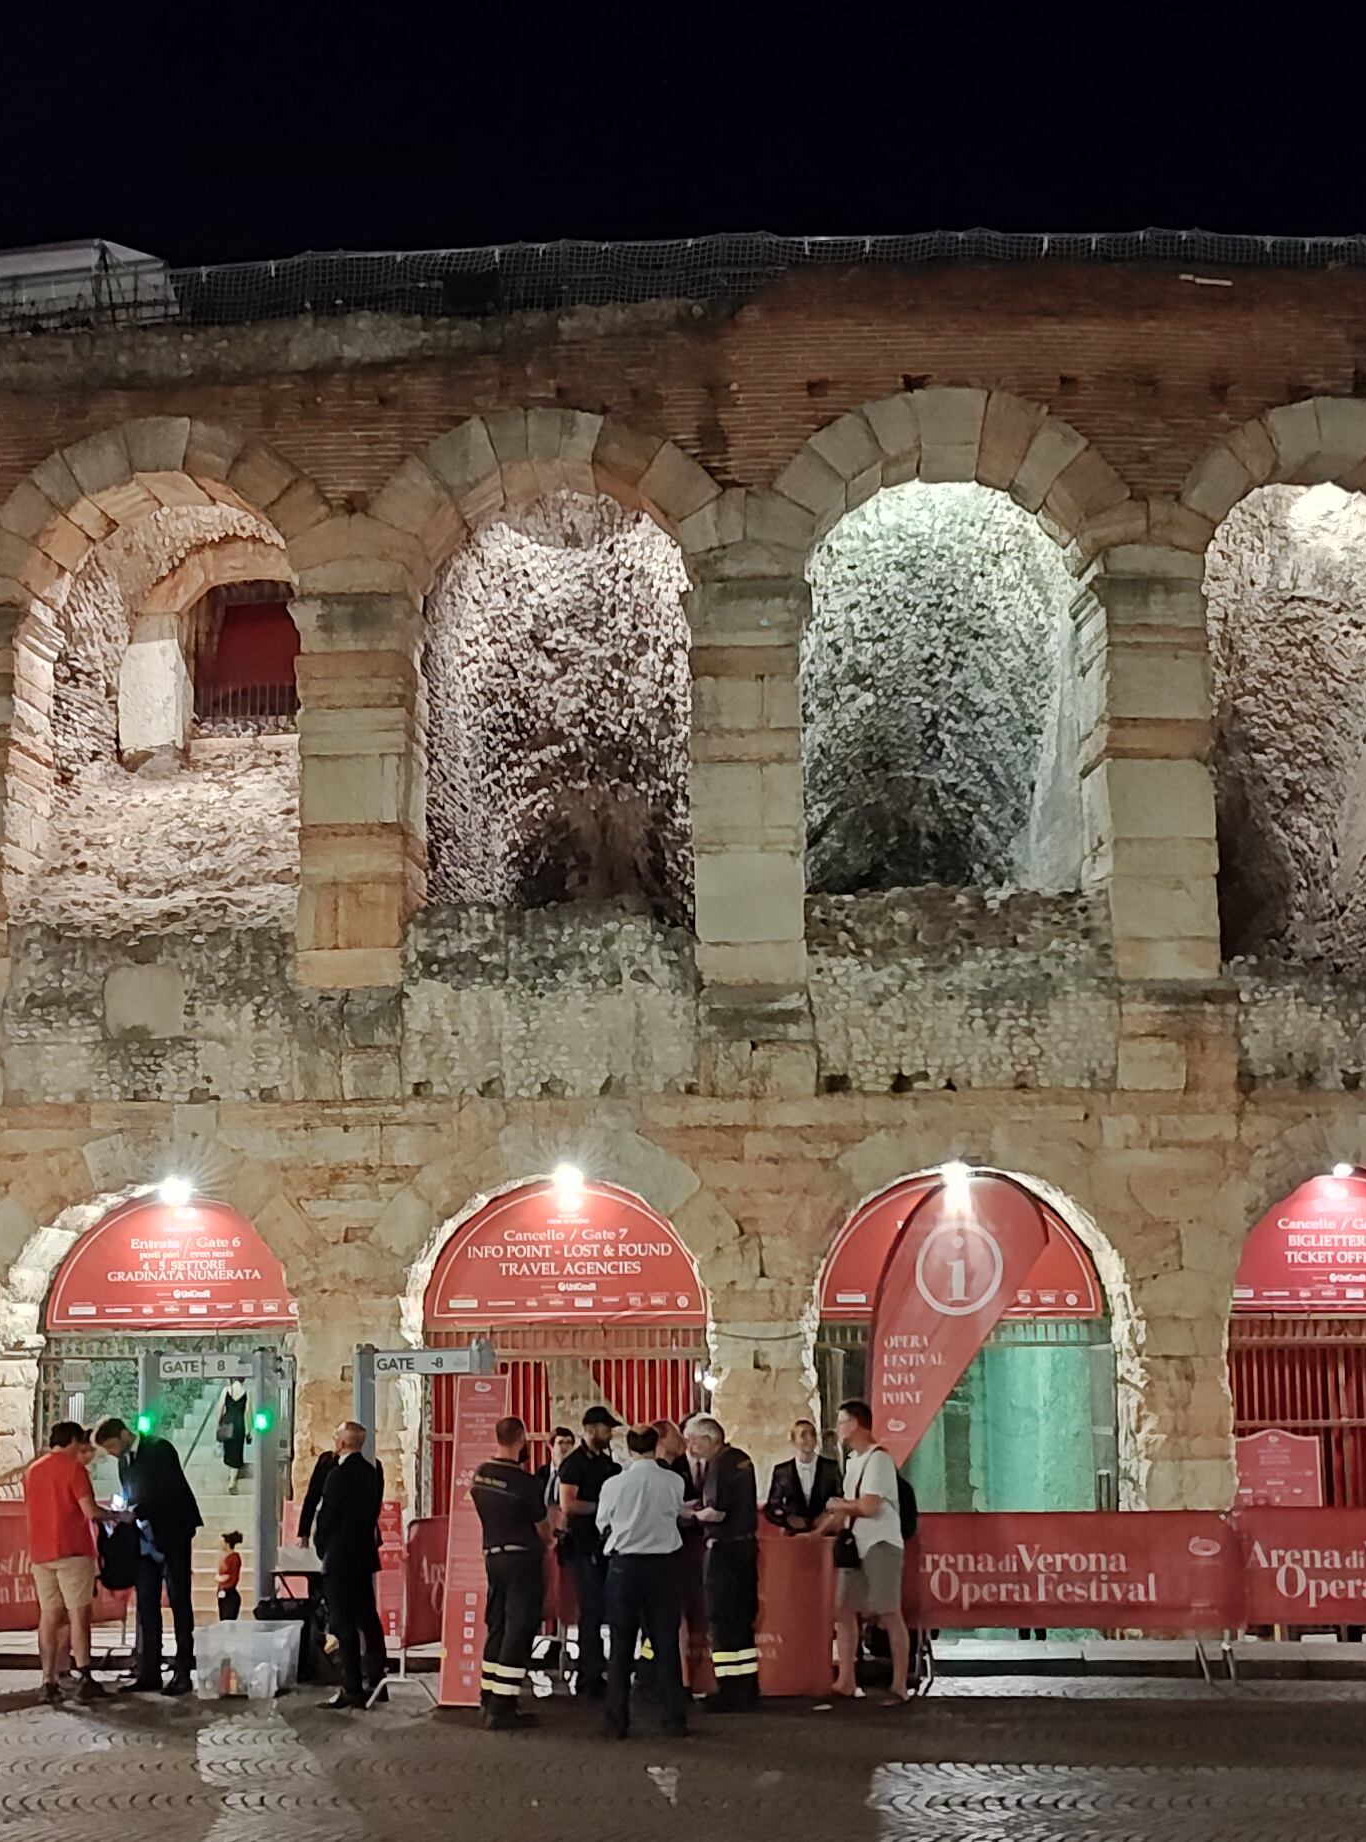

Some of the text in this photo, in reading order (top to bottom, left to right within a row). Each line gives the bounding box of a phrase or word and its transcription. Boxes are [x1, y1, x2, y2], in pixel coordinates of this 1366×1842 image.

[1277, 1218, 1337, 1230] Cancello
[503, 1229, 565, 1241] Cancello
[581, 1229, 615, 1241] Gate
[618, 1228, 629, 1241] 7
[196, 1236, 230, 1249] Gate
[231, 1236, 242, 1248] 6
[467, 1245, 503, 1259] INFO
[506, 1245, 552, 1258] POINT
[563, 1244, 600, 1257] LOST
[603, 1244, 615, 1257] &
[618, 1243, 673, 1257] FOUND
[1285, 1251, 1334, 1264] TICKET
[170, 1260, 227, 1270] SETTORE
[499, 1261, 642, 1276] TRAVEL AGENCIES
[107, 1268, 262, 1283] GRADINATA NUMERATA
[883, 1334, 930, 1349] OPERA
[162, 1359, 226, 1374] GATE 8
[376, 1356, 415, 1371] GATE
[882, 1351, 947, 1368] FESTIVAL
[881, 1372, 916, 1386] INFO
[881, 1390, 923, 1405] POINT
[920, 1543, 1127, 1573] rena di Verona
[1247, 1540, 1342, 1570] Arena
[1344, 1550, 1364, 1570] di
[929, 1567, 1158, 1611] Opera Festival
